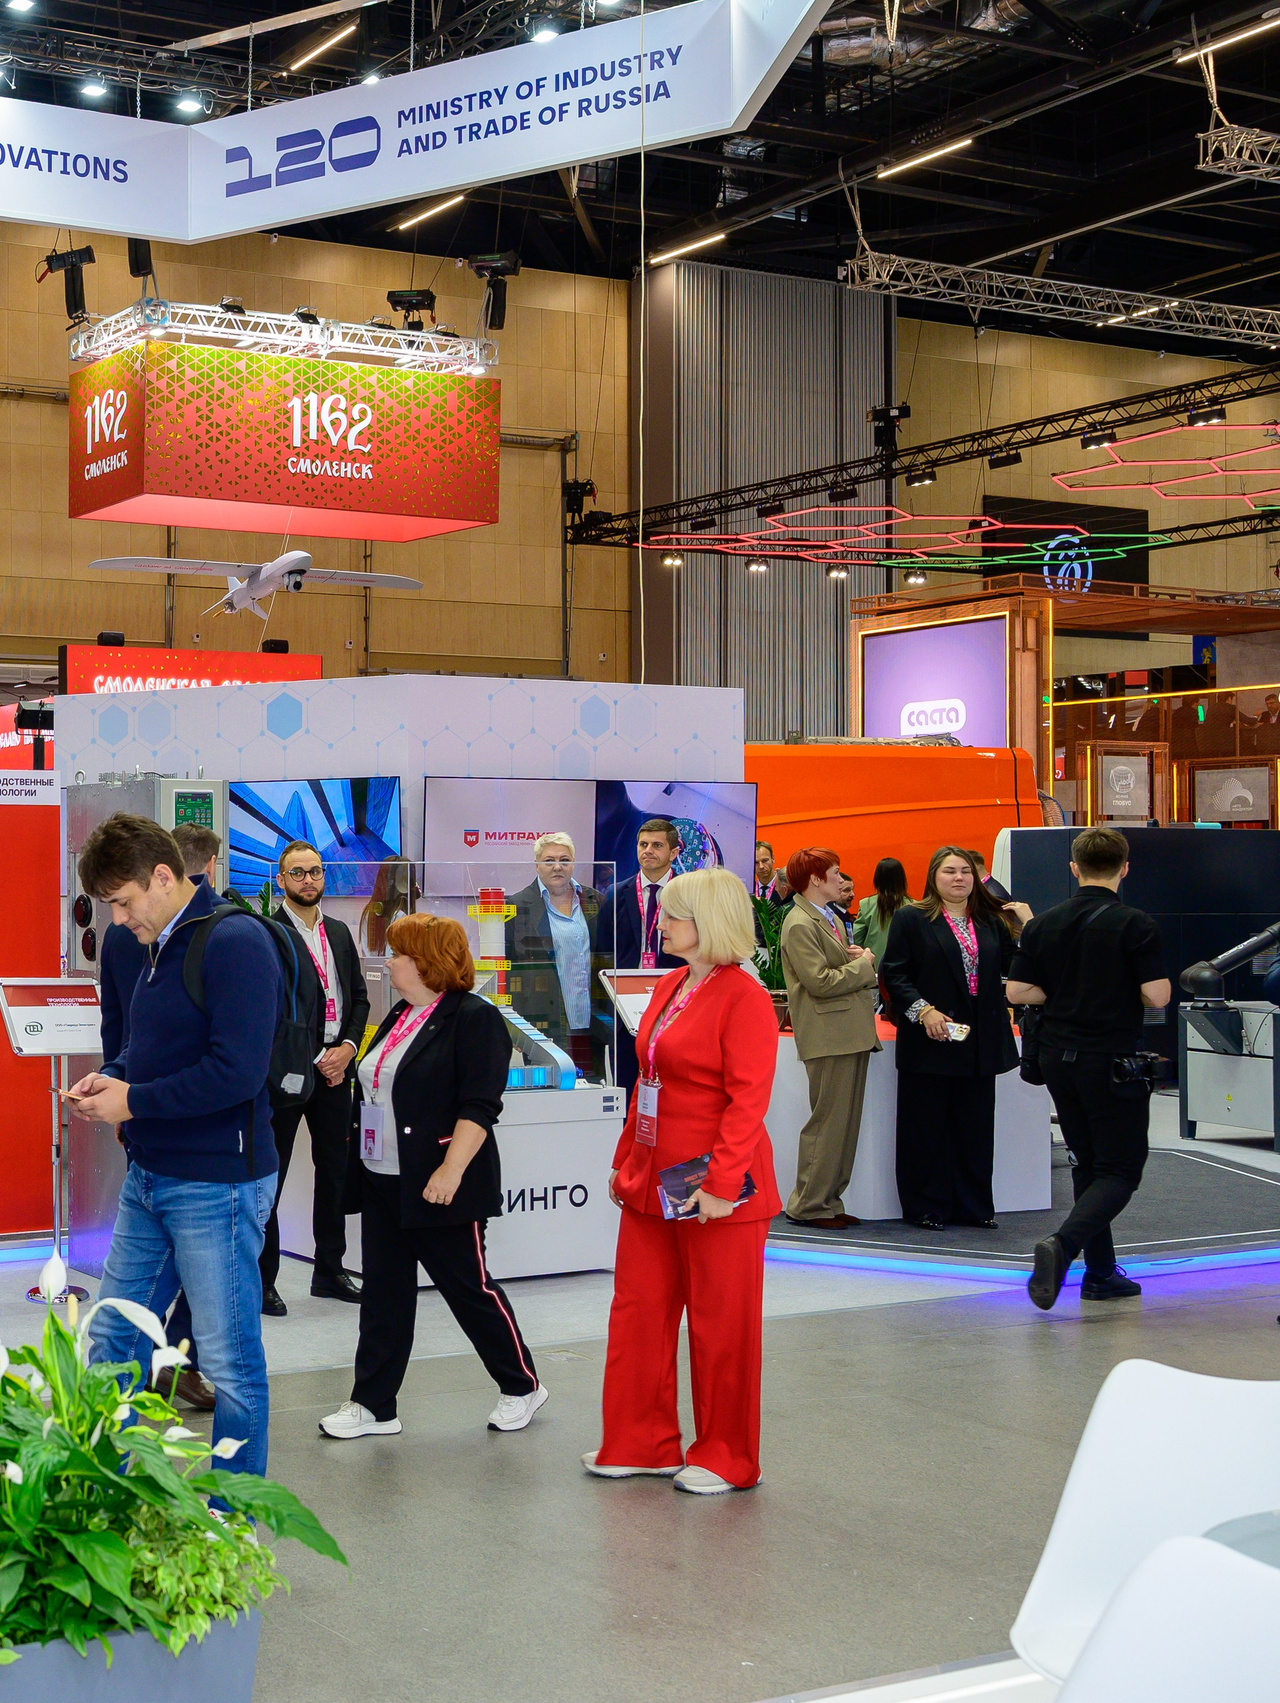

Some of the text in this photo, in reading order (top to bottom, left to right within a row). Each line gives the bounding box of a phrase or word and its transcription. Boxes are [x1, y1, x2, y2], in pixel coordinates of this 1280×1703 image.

[396, 44, 684, 129] MINISTRY OF INDUSTRY
[396, 79, 672, 158] AND TRADE OF RUSSIA
[224, 114, 382, 198] 120
[84, 388, 128, 456] 1162
[287, 391, 373, 454] 1162
[84, 449, 128, 482] СМОЛЕНСК
[287, 456, 374, 480] СМОЛЕНСК
[484, 831, 556, 841] МИТРАК
[501, 1184, 589, 1214] ИНГО
